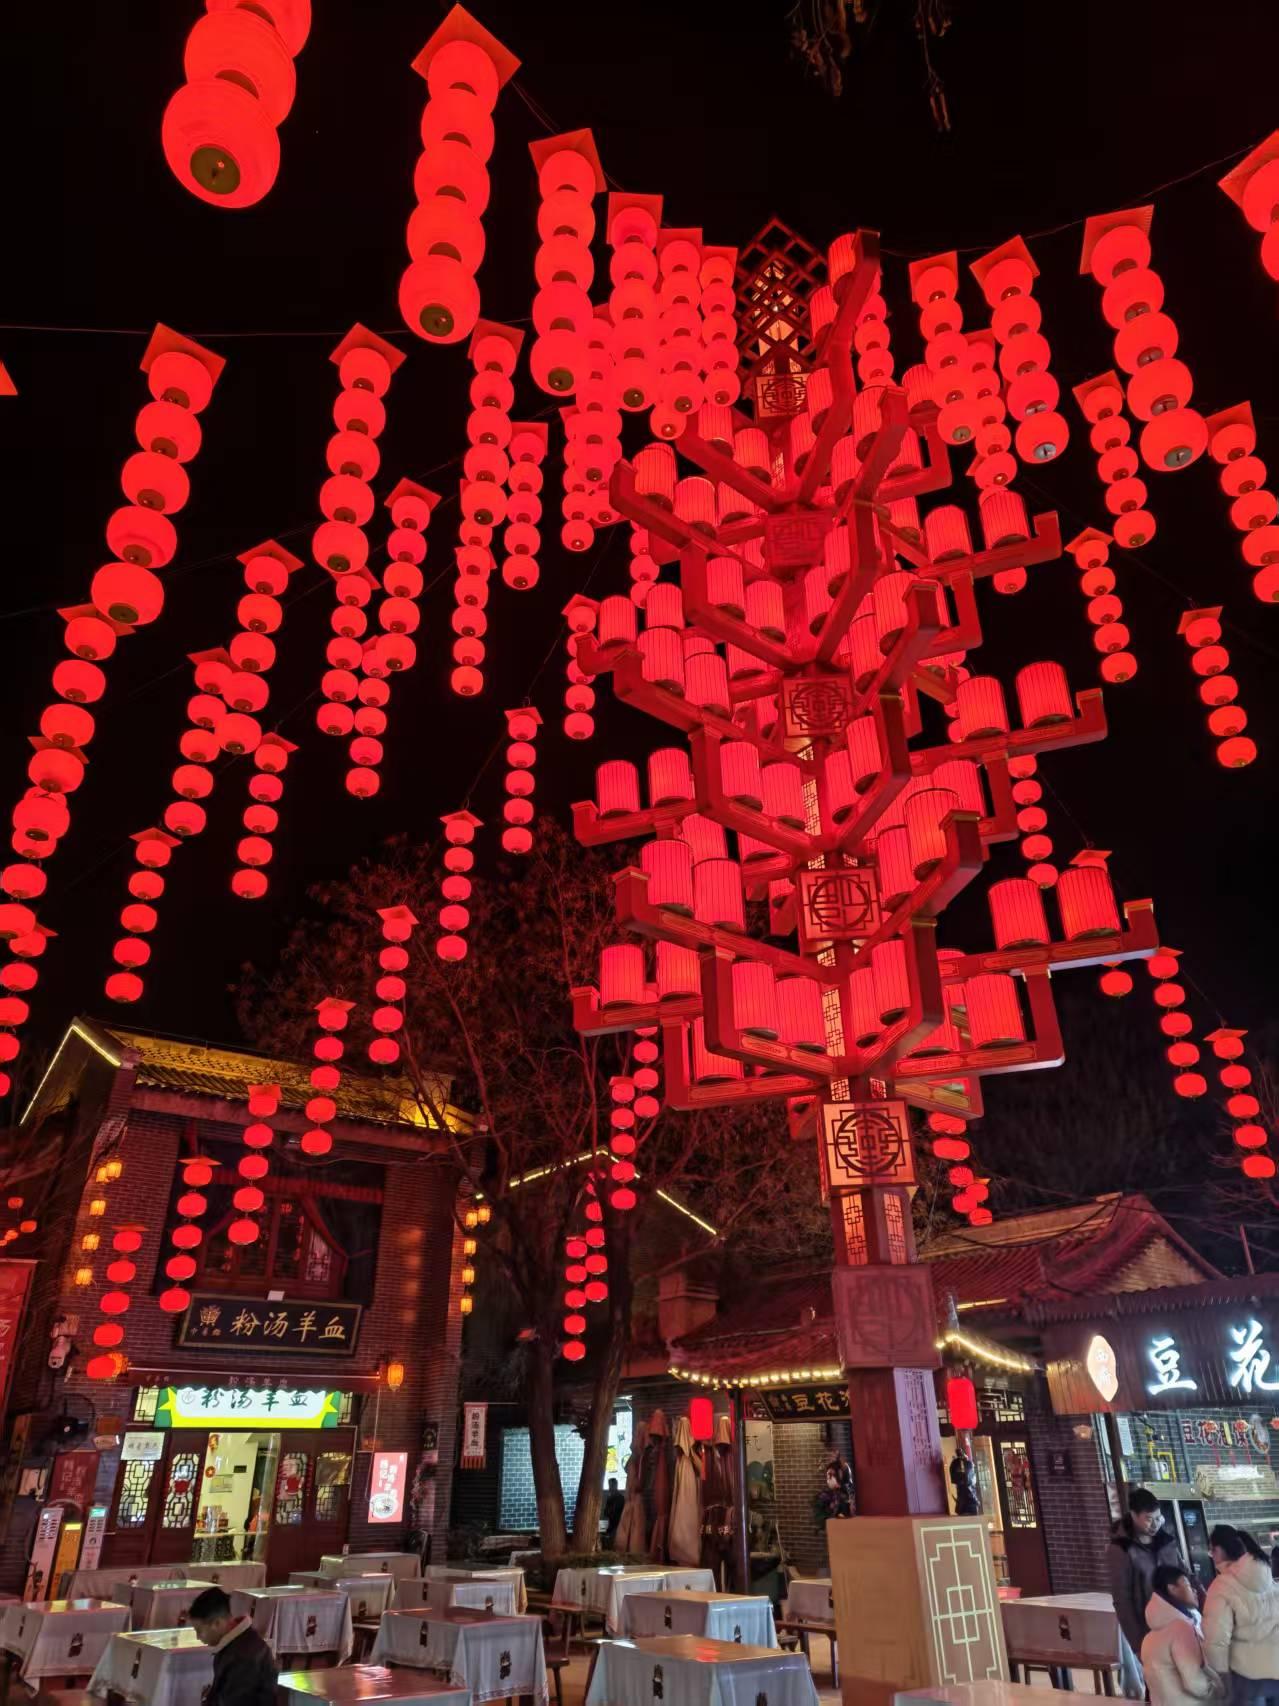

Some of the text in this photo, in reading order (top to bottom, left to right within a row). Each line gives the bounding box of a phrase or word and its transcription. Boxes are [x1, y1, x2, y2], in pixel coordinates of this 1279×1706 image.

[230, 1308, 346, 1343] 粉汤羊血
[1147, 1319, 1279, 1396] 豆花
[201, 1387, 308, 1412] 粉汤羊血
